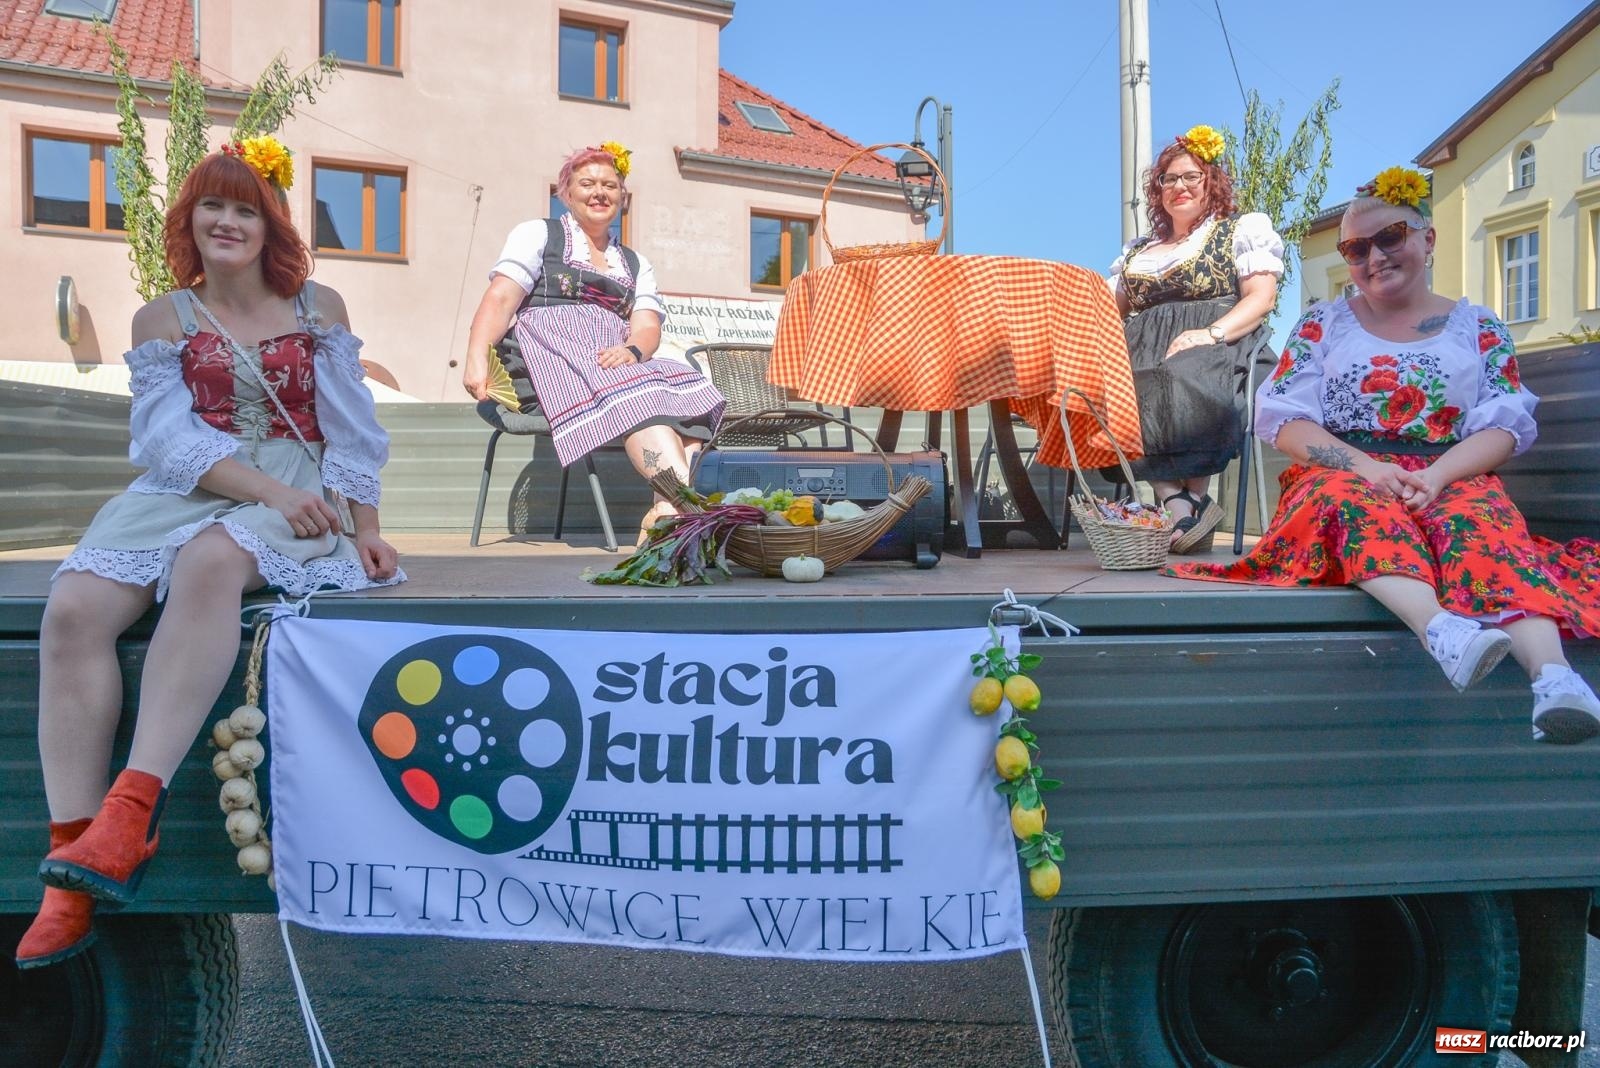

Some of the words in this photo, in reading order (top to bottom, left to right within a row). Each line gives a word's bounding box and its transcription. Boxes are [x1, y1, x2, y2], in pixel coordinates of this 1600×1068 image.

[713, 307, 725, 318] Z
[726, 306, 776, 321] ROŻNA
[593, 646, 838, 727] stacja
[585, 711, 895, 786] kultura
[307, 860, 708, 946] PIETROWICE
[740, 889, 1008, 954] WIELKIE
